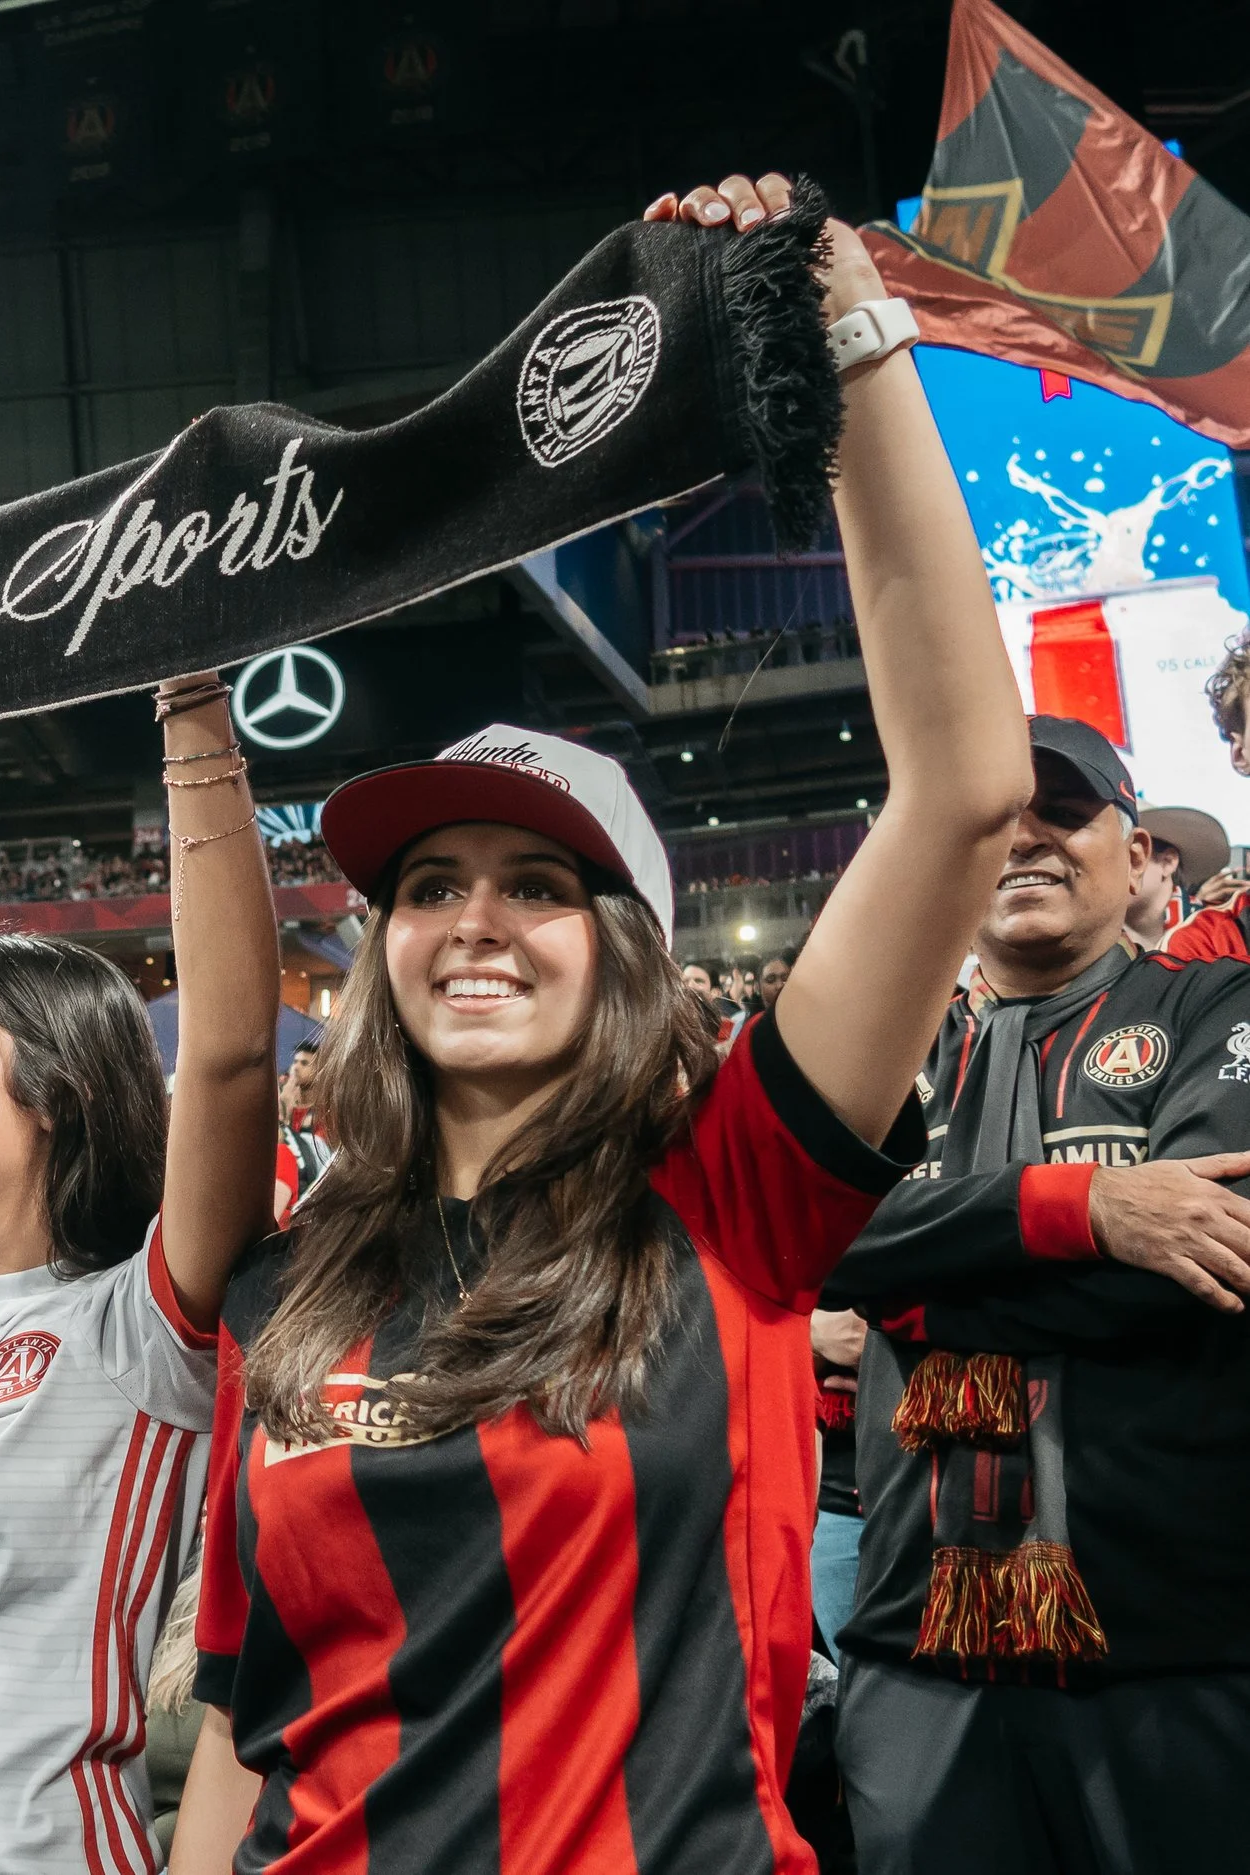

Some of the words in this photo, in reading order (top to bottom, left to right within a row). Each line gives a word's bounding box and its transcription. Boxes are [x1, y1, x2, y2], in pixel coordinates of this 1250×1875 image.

[1156, 659, 1178, 673] 95
[1103, 1025, 1158, 1044] ATLANTA
[1089, 1067, 1134, 1085] UNITED
[1139, 1065, 1156, 1080] FC
[1050, 1142, 1149, 1168] AMILY
[20, 1376, 39, 1388] FC
